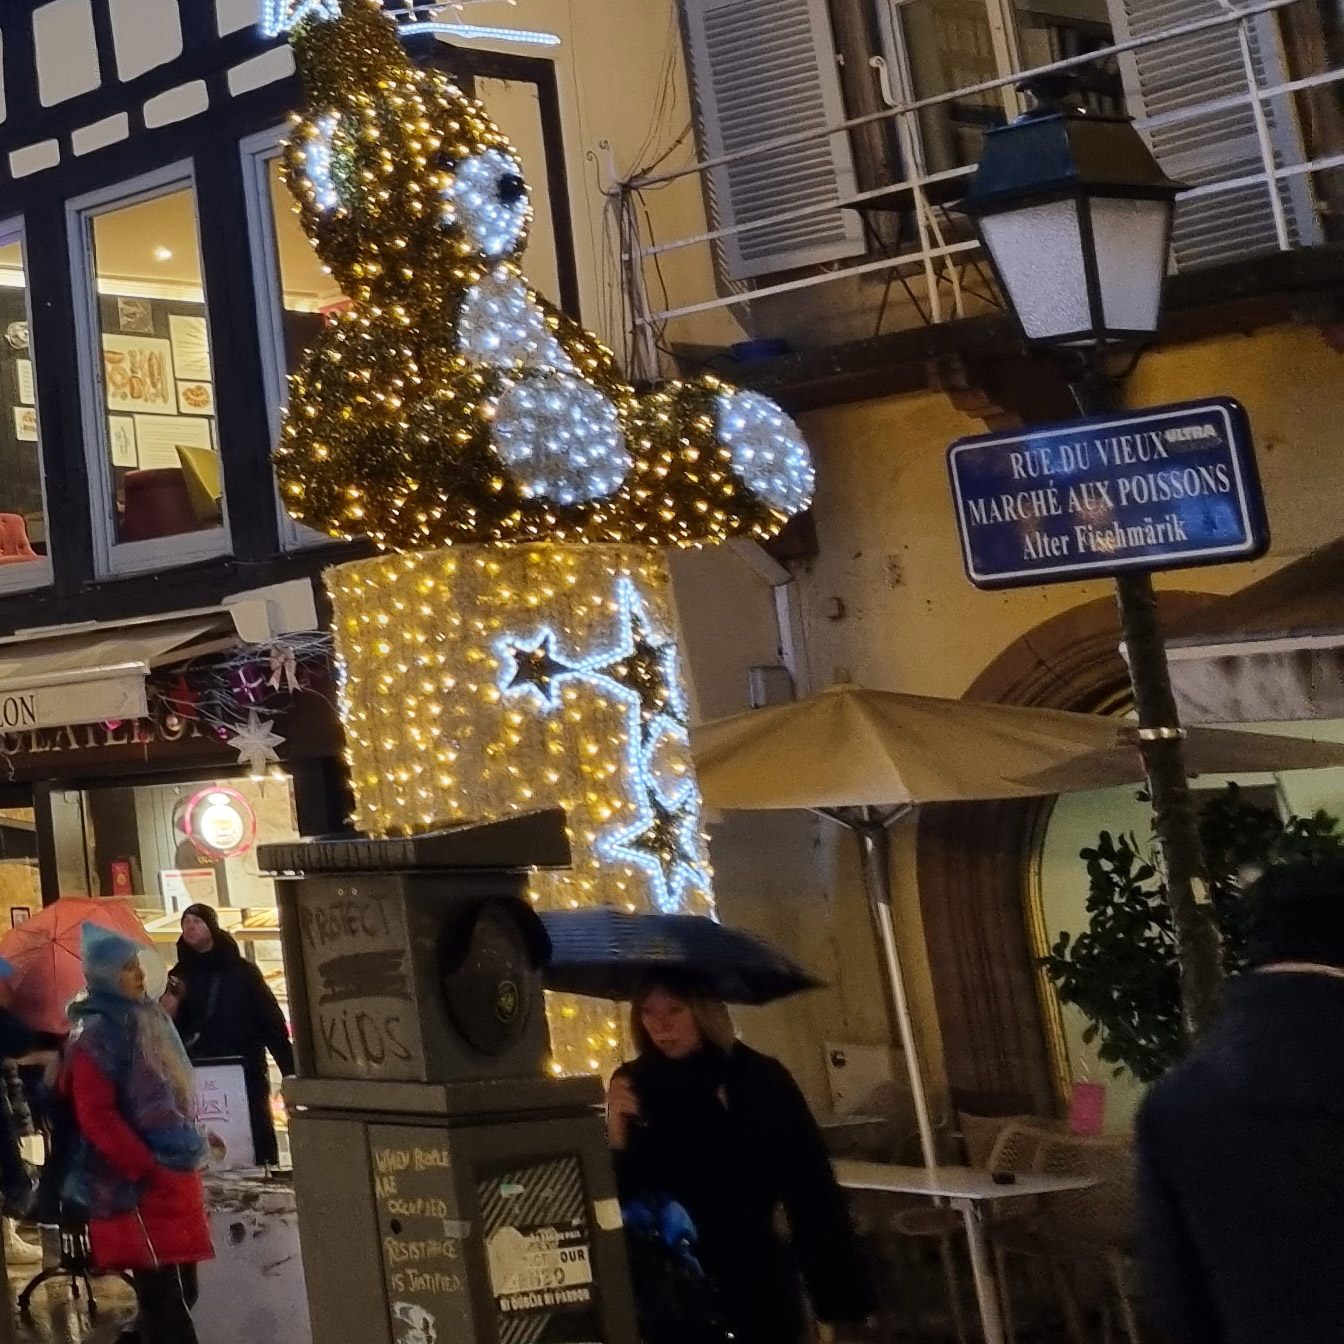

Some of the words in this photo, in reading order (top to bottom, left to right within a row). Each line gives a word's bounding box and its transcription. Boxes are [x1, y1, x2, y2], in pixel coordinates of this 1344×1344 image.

[1009, 447, 1053, 480] RUE
[1061, 441, 1090, 472] DU
[1098, 430, 1169, 467] VIEUX
[967, 481, 1062, 526] MARCHÉ
[1068, 481, 1114, 513] AUX
[1118, 463, 1231, 508] POISSONS
[1023, 531, 1069, 561] Alter
[1074, 514, 1188, 553] Fischmärik
